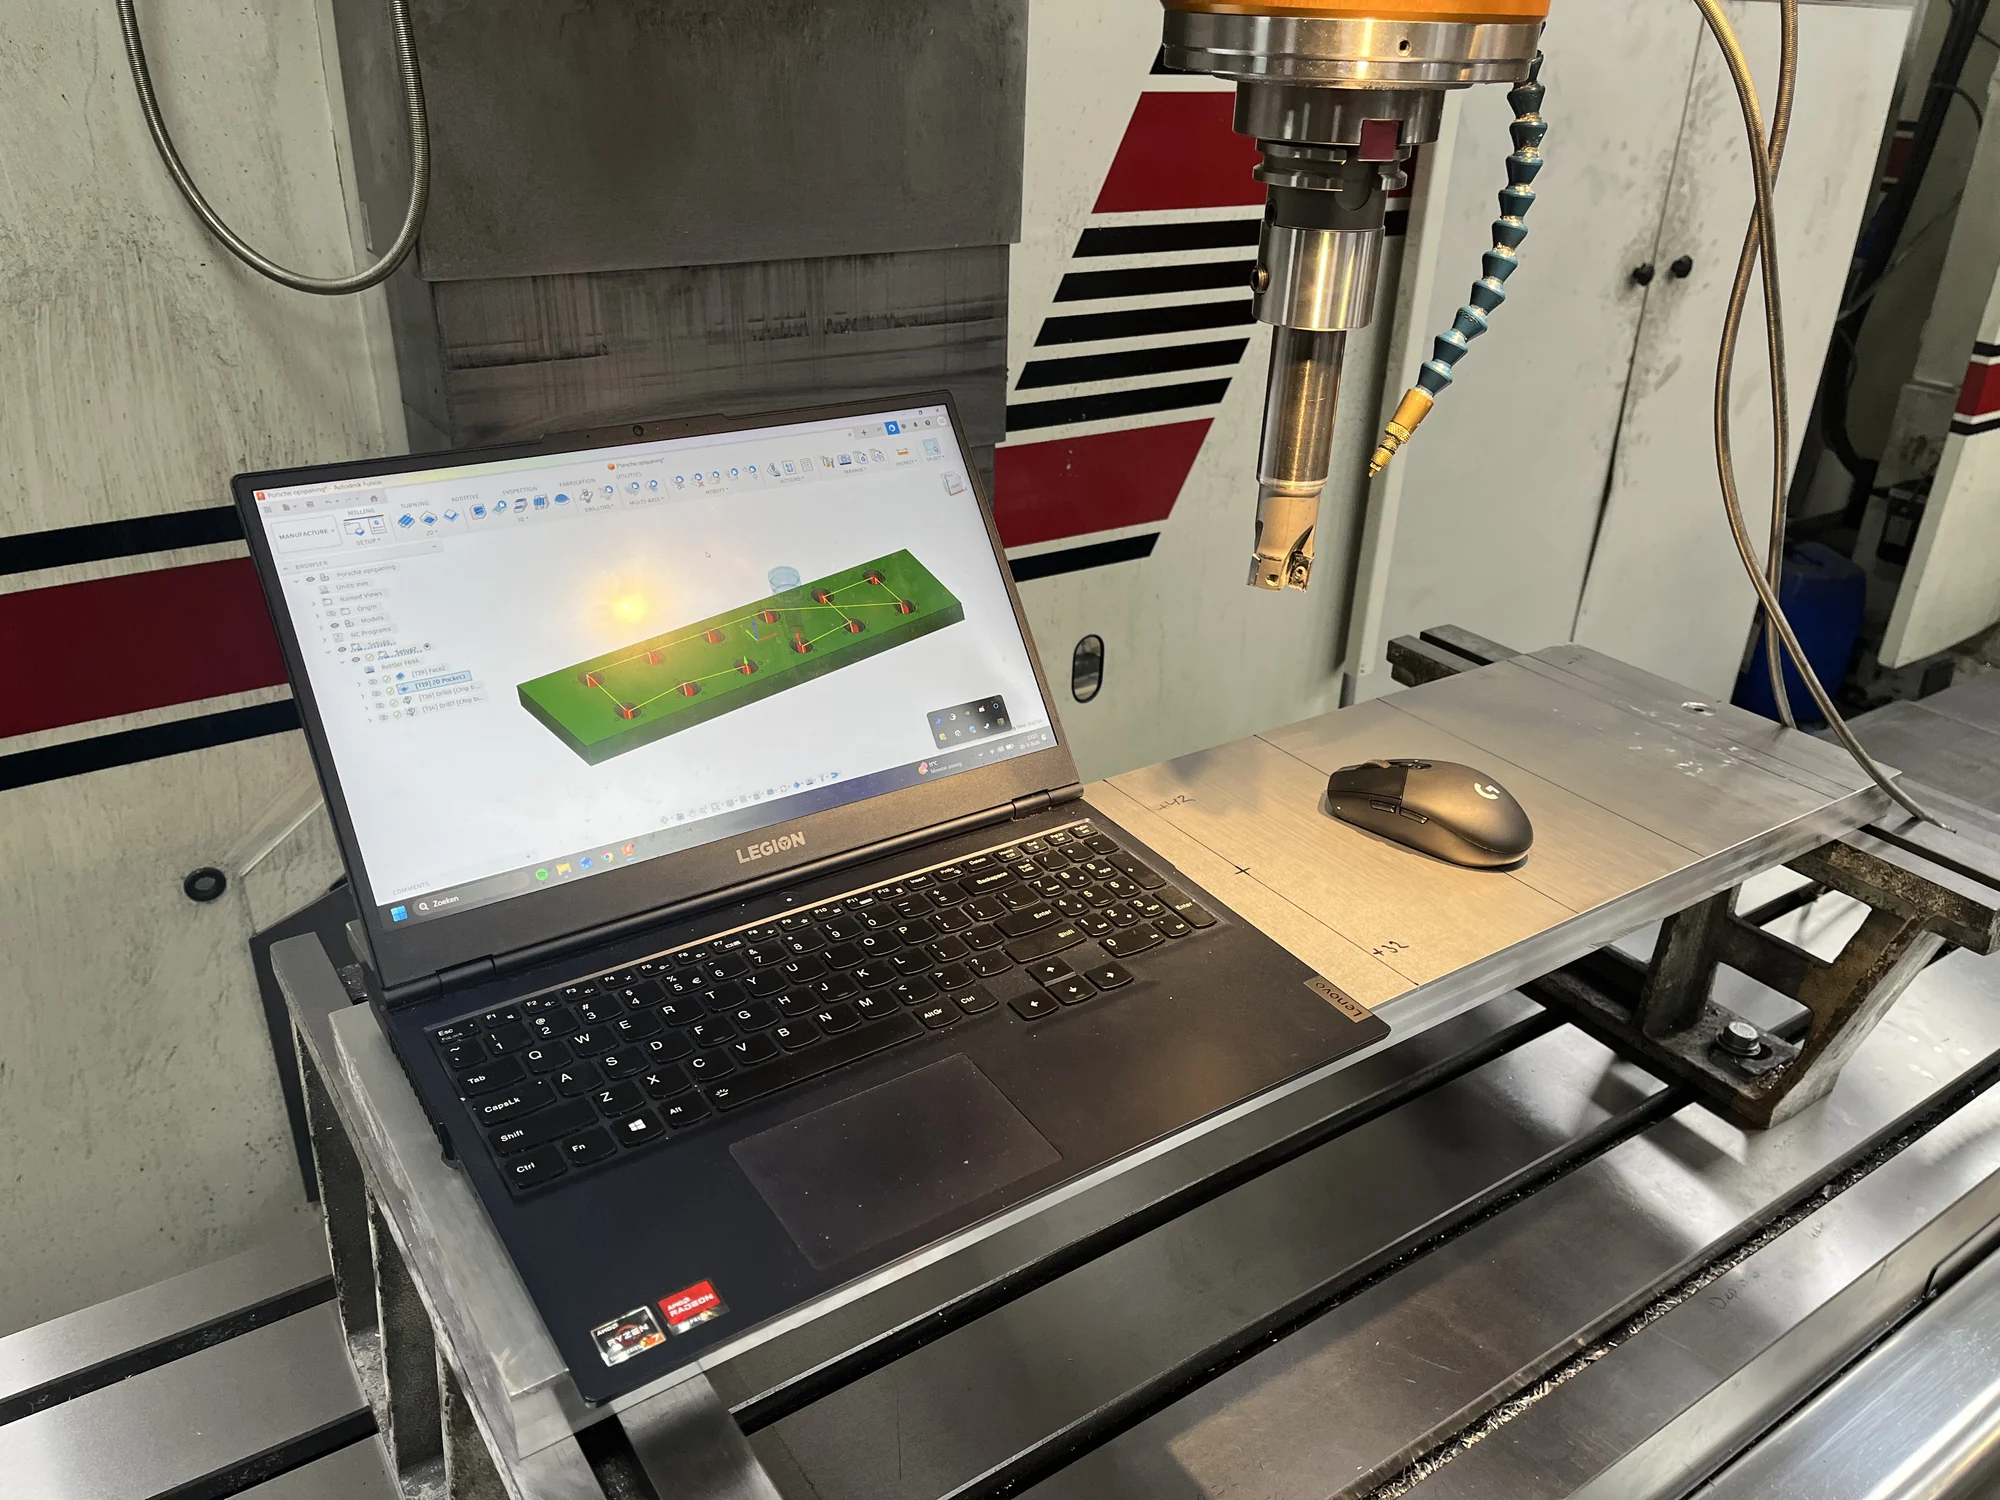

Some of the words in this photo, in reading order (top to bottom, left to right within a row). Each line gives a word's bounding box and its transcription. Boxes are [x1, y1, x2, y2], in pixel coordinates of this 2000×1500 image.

[616, 471, 642, 480] UTILITIES
[559, 478, 596, 488] FABRICATION
[267, 490, 292, 498] Porsche
[333, 482, 361, 491] Autodesk
[502, 486, 538, 496] INSPECTION
[451, 494, 479, 503] ADDITIVE
[400, 500, 430, 509] TURNING
[584, 505, 611, 513] DRILLING
[348, 507, 375, 516] MILLING
[279, 528, 328, 540] MANUFACTURE
[356, 538, 376, 547] SETUP
[295, 560, 329, 570] BROWSER
[336, 569, 362, 578] Porsche
[336, 583, 355, 591] Units:
[339, 593, 363, 602] Named
[363, 591, 383, 599] Views
[357, 604, 377, 612] Origin
[361, 615, 384, 624] Models
[361, 627, 391, 637] Programs
[428, 665, 446, 674] Face2
[735, 831, 806, 864] LEGION
[392, 881, 430, 896] COMMENTS
[432, 895, 460, 908] Zoeken
[1176, 902, 1192, 910] Enter
[1034, 910, 1052, 919] Enter
[899, 926, 907, 934] P
[786, 964, 798, 972] U
[857, 969, 869, 977] K
[747, 977, 757, 985] Y
[705, 991, 716, 999] T
[1315, 982, 1363, 1017] Lenovo
[632, 997, 640, 1005] 4
[778, 996, 791, 1004] H
[859, 998, 874, 1008] M
[961, 996, 975, 1004] Ctrl
[662, 1006, 676, 1014] R
[738, 1010, 751, 1019] G
[924, 1008, 942, 1018] AltGr
[819, 1012, 832, 1022] N
[619, 1020, 632, 1030] E
[438, 1028, 454, 1036] Esc
[694, 1026, 704, 1035] F
[778, 1028, 790, 1037] B
[574, 1034, 590, 1044] W
[650, 1041, 662, 1050] D
[736, 1043, 747, 1051] V
[528, 1051, 543, 1060] Q
[605, 1056, 618, 1066] S
[693, 1059, 706, 1068] C
[468, 1075, 486, 1085] Tab
[561, 1073, 572, 1082] A
[647, 1075, 660, 1085] X
[600, 1091, 613, 1102] Z
[484, 1097, 521, 1113] CapsLk
[670, 1106, 682, 1115] Alt
[500, 1130, 524, 1142] Shift
[572, 1144, 586, 1152] Fn
[516, 1162, 535, 1173] Ctrl
[667, 1296, 691, 1312] AMD
[669, 1293, 714, 1317] RADEON
[597, 1323, 618, 1337] AMD
[607, 1323, 649, 1347] RYZEN
